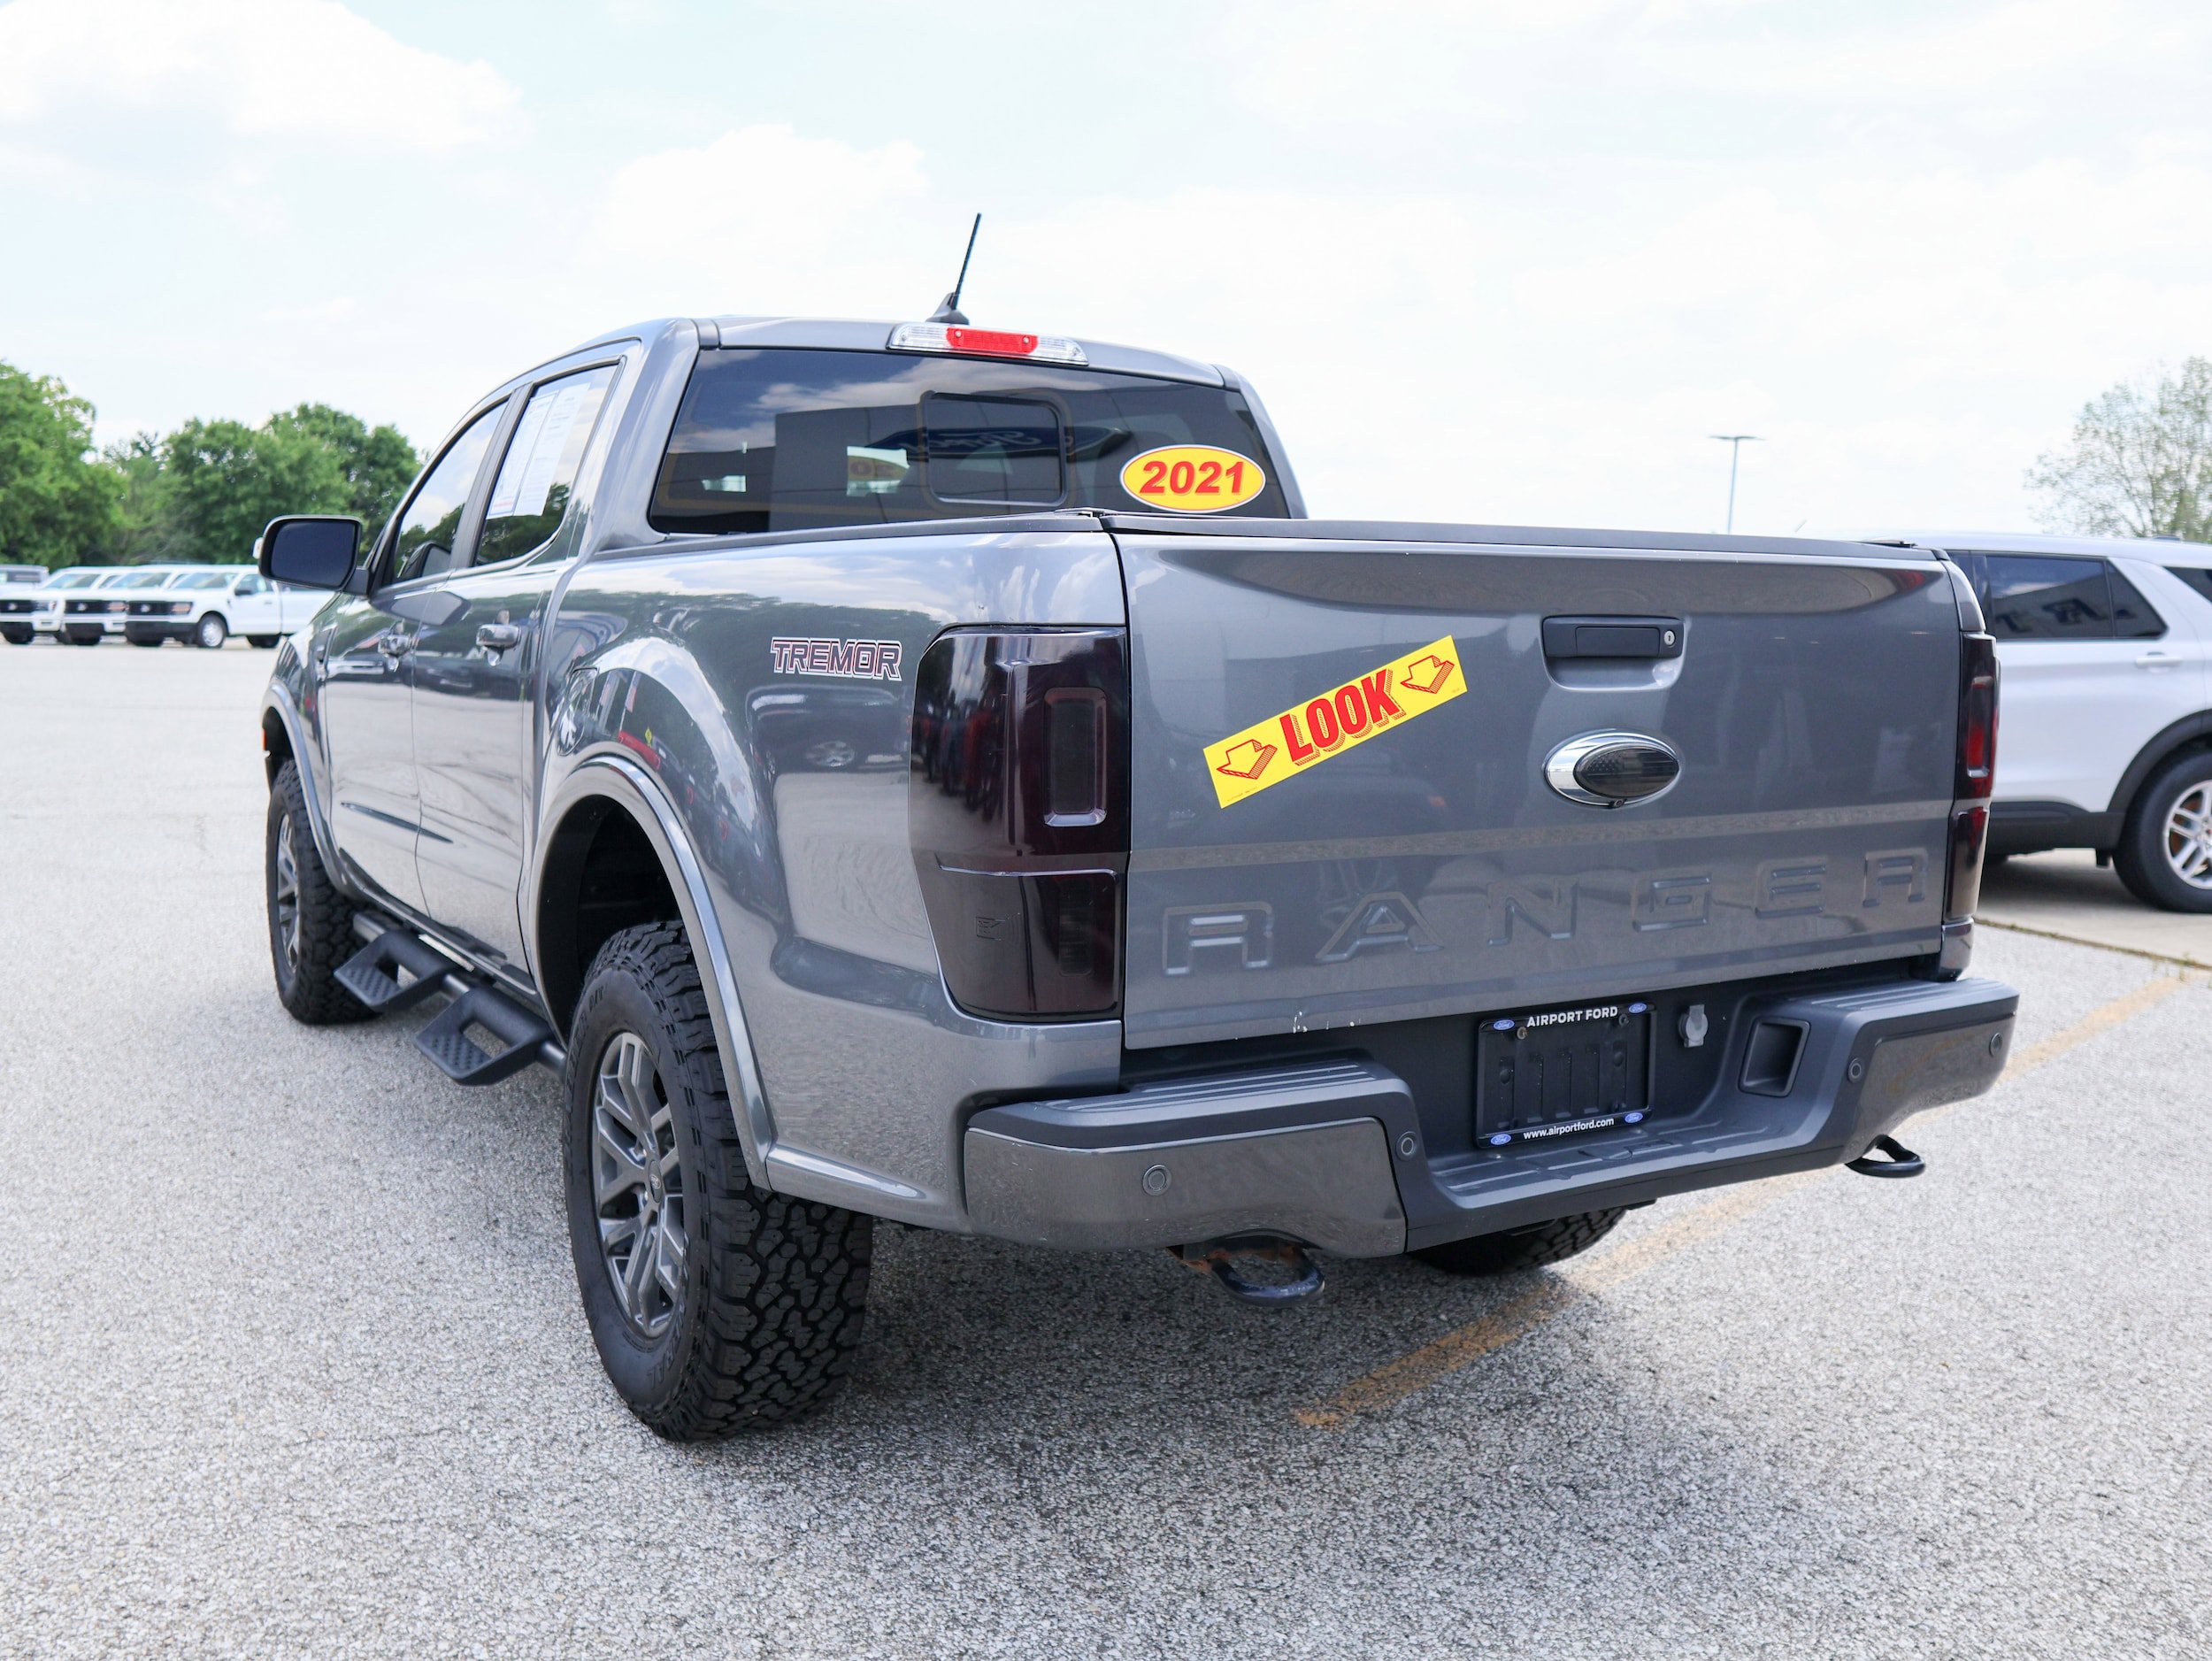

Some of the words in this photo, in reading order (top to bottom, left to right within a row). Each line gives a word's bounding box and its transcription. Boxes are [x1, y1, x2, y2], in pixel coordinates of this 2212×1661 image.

[1140, 461, 1245, 496] 2021
[770, 636, 902, 681] TREMOR
[1279, 669, 1406, 766] LOOK
[1162, 847, 1929, 977] RANGER
[1526, 1011, 1583, 1028] AIRPORT
[1586, 1006, 1618, 1020] FORD
[1523, 1118, 1615, 1141] www.airportford.com
